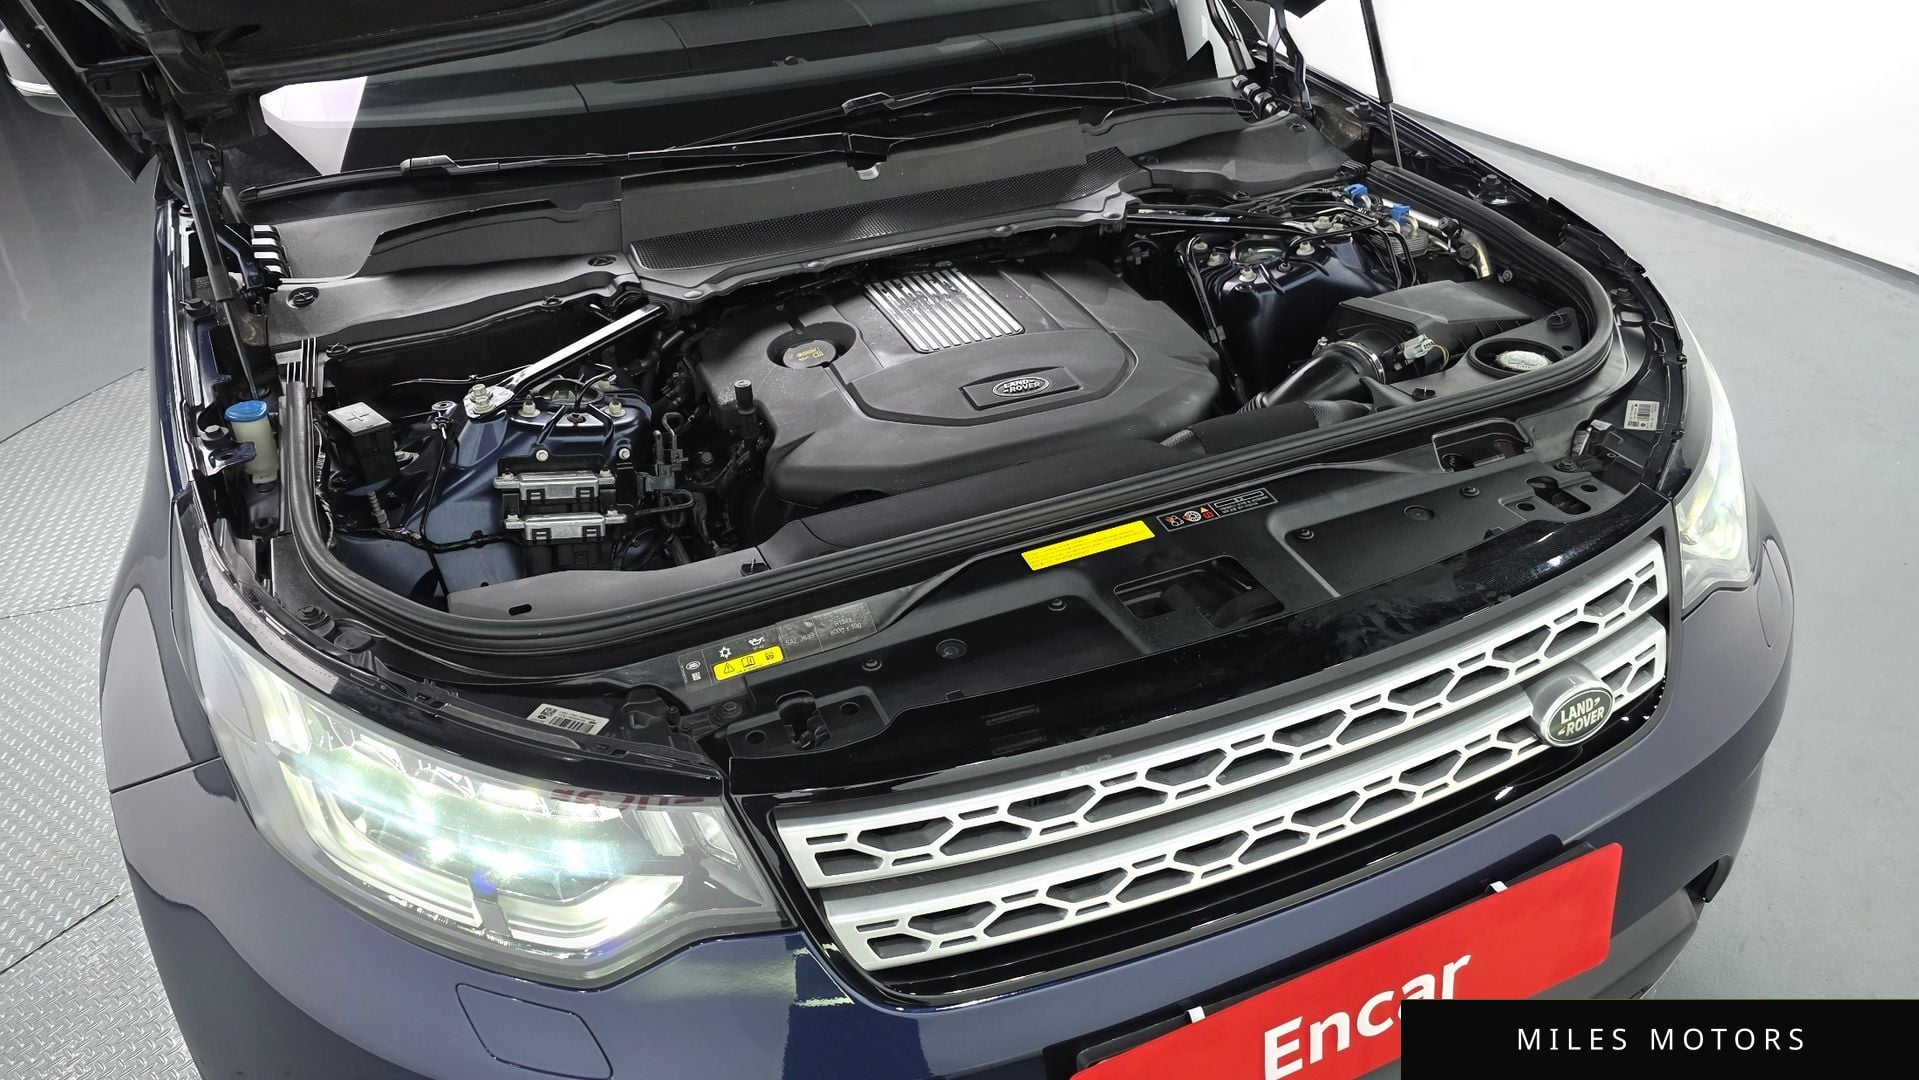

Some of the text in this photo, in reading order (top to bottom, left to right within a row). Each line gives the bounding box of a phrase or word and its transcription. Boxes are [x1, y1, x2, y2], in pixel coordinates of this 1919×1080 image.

[1003, 379, 1029, 389] LAND
[1009, 382, 1040, 393] ROVER
[1560, 697, 1594, 725] LAND
[1565, 706, 1605, 736] ROVER
